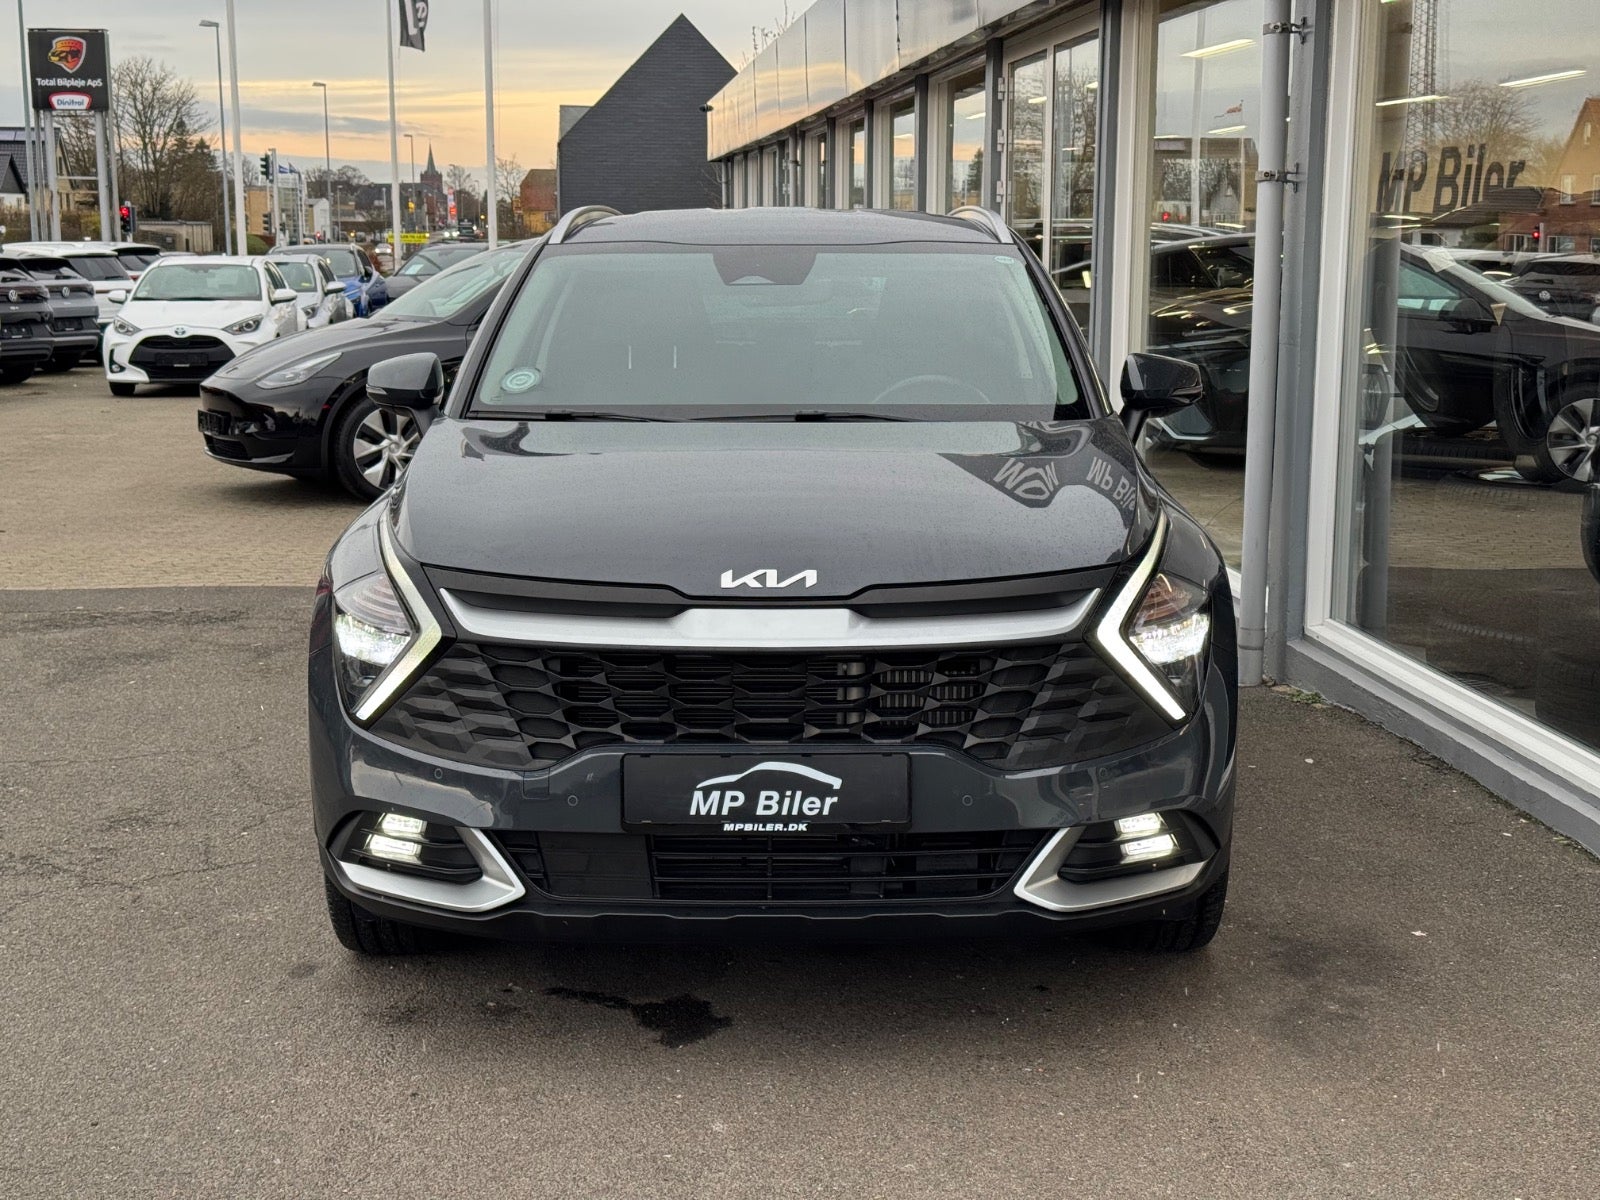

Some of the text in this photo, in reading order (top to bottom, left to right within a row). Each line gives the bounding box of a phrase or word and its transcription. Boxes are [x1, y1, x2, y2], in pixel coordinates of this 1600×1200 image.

[36, 78, 103, 88] Total Bilpleje ApS
[56, 98, 85, 106] Dinitrol
[1432, 143, 1526, 213] Biler
[720, 569, 818, 589] KIA
[689, 790, 838, 816] MP Biler
[723, 823, 809, 832] MPBILER.DK
